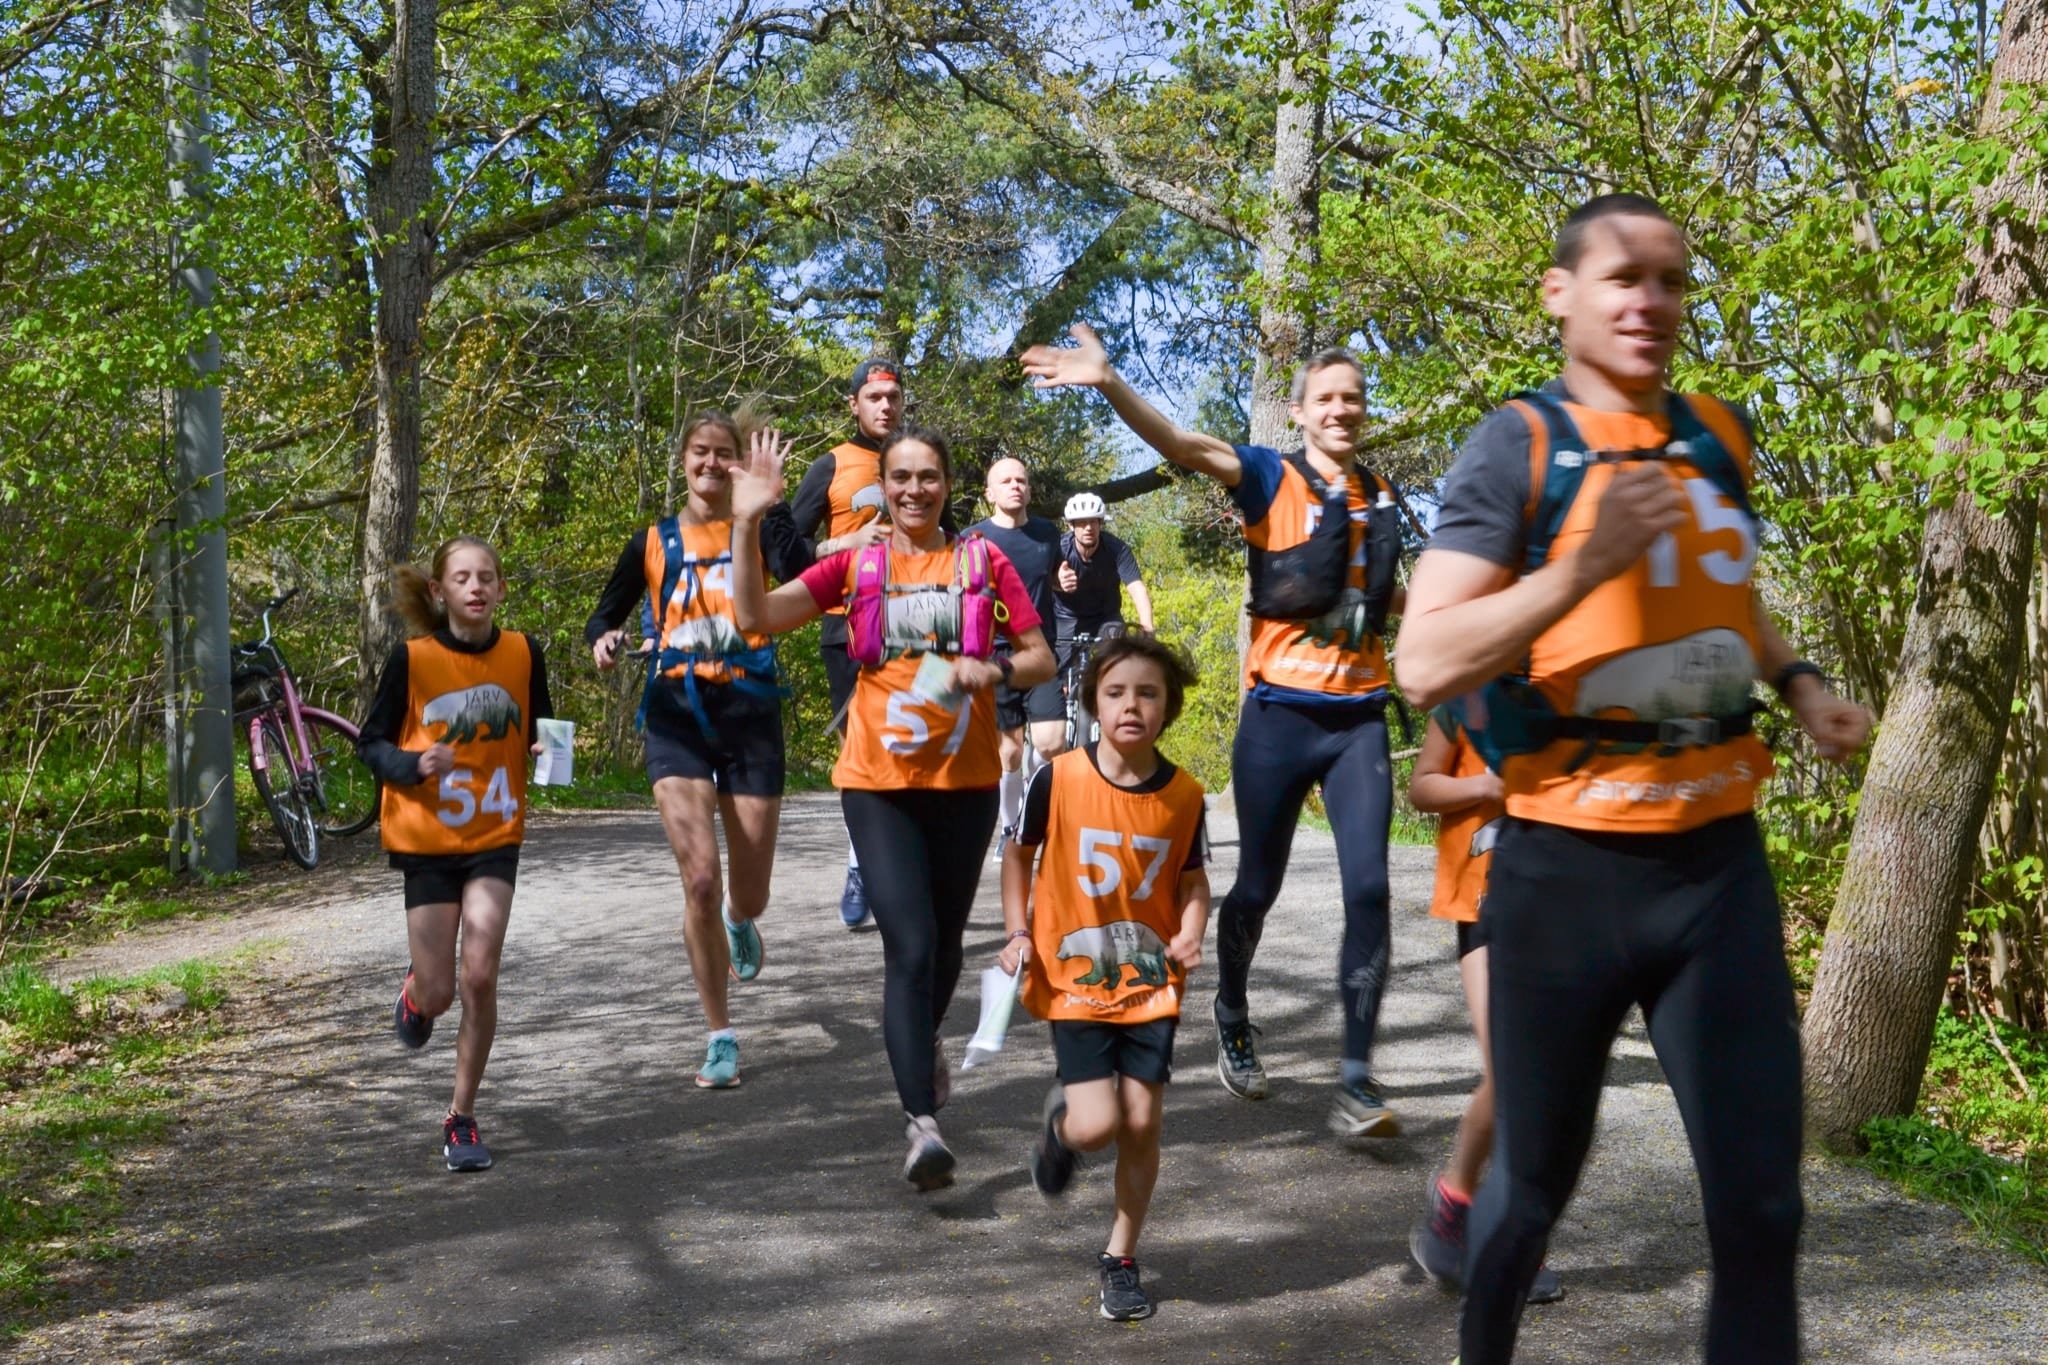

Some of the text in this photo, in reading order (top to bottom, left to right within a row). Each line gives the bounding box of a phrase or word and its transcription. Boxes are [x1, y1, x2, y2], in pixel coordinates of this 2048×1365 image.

[880, 689, 974, 756] 57
[437, 766, 519, 828] 54
[1077, 826, 1173, 901] 57
